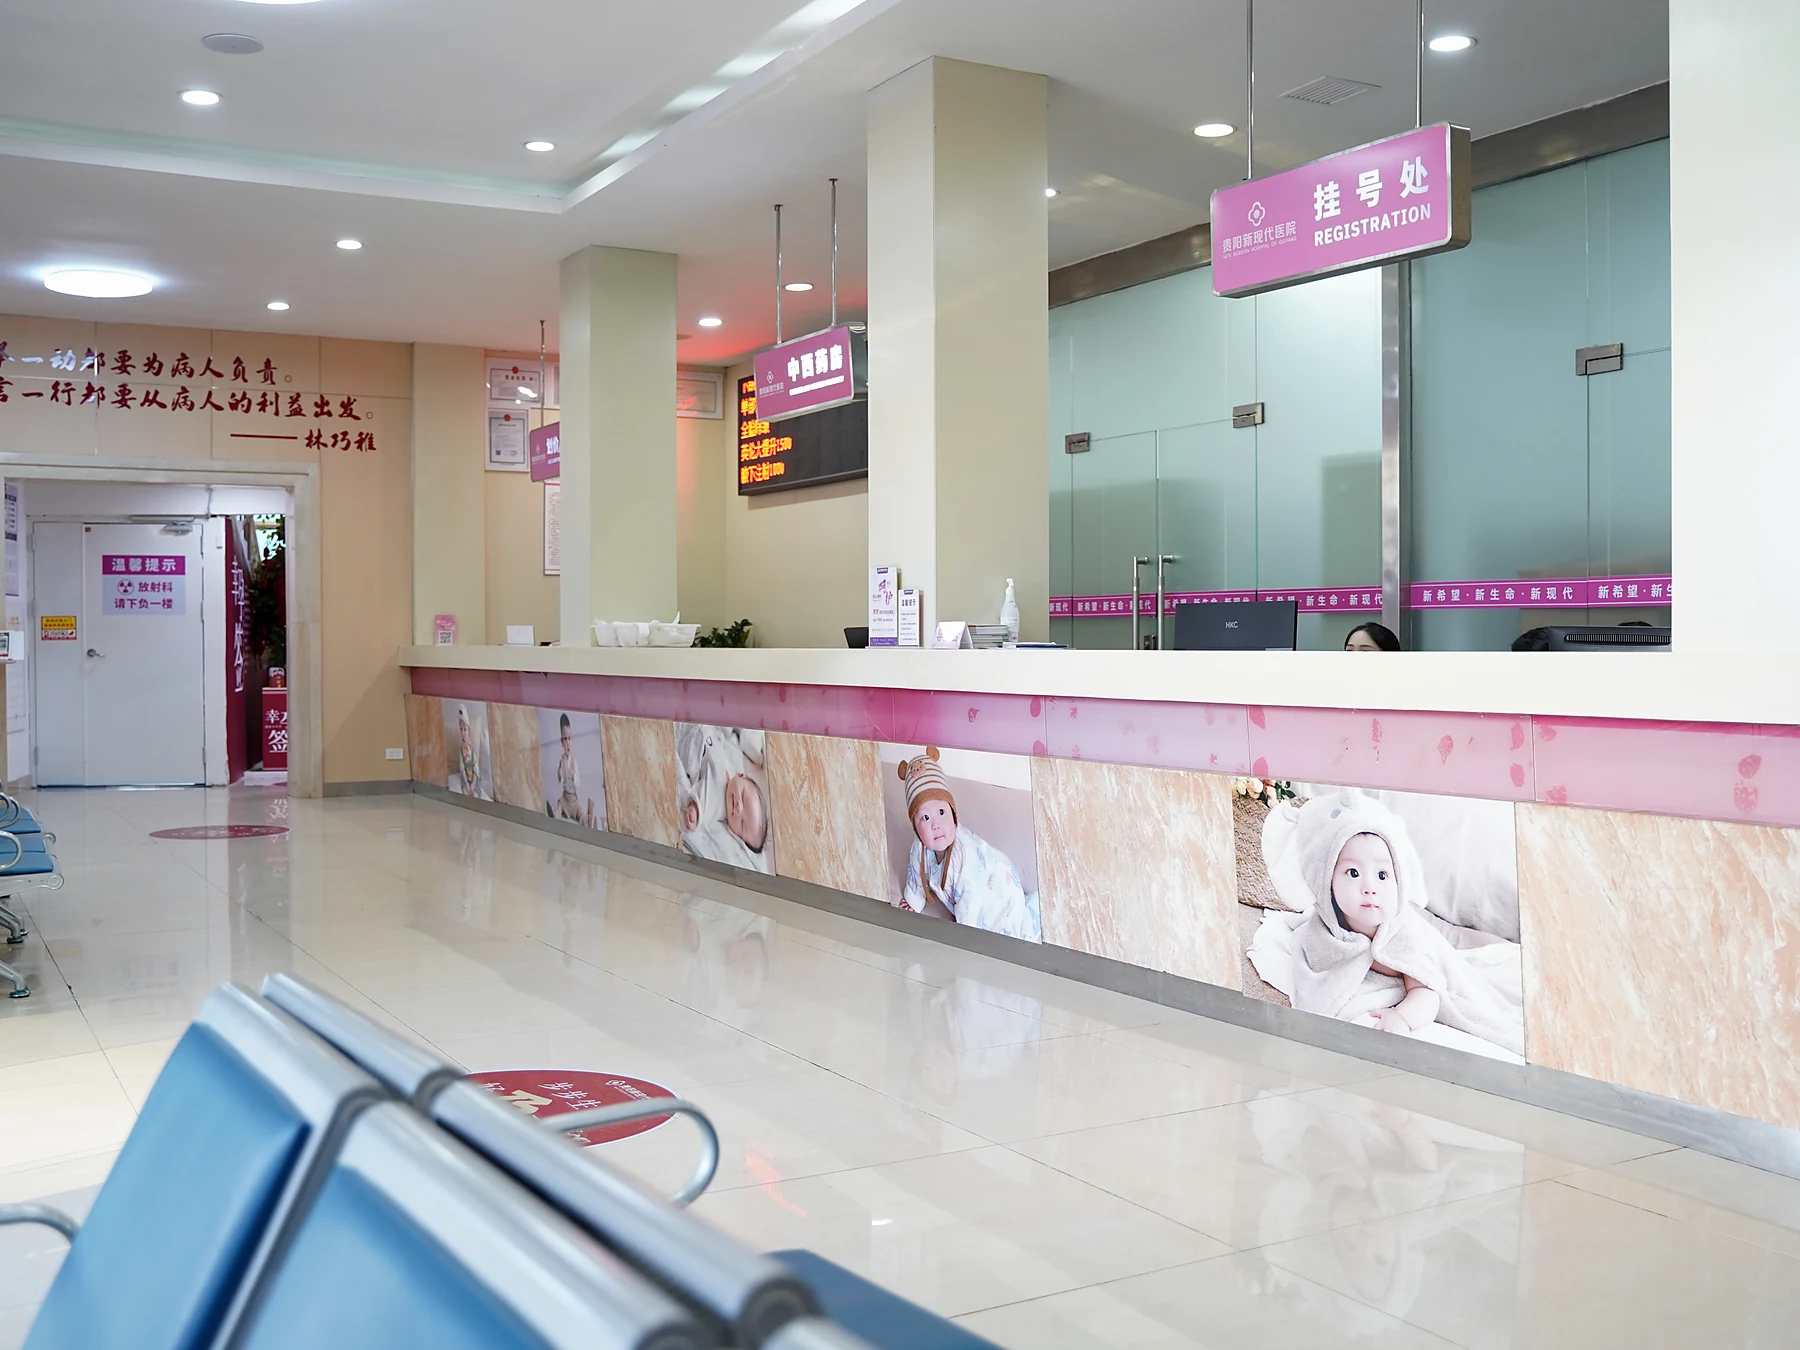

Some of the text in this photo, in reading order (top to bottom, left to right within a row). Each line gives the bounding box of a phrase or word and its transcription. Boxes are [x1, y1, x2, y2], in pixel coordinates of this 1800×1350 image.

[1313, 156, 1430, 222] 挂号处
[1314, 203, 1431, 247] REGISTRATION
[1222, 221, 1297, 254] 贵阳新现代医院
[1233, 249, 1250, 257] MODERN
[1251, 243, 1270, 252] HOSPITAL
[111, 557, 177, 572] 温馨提示
[138, 581, 173, 593] 放射科
[114, 598, 173, 609] 请下负一楼
[1225, 621, 1239, 629] HKC
